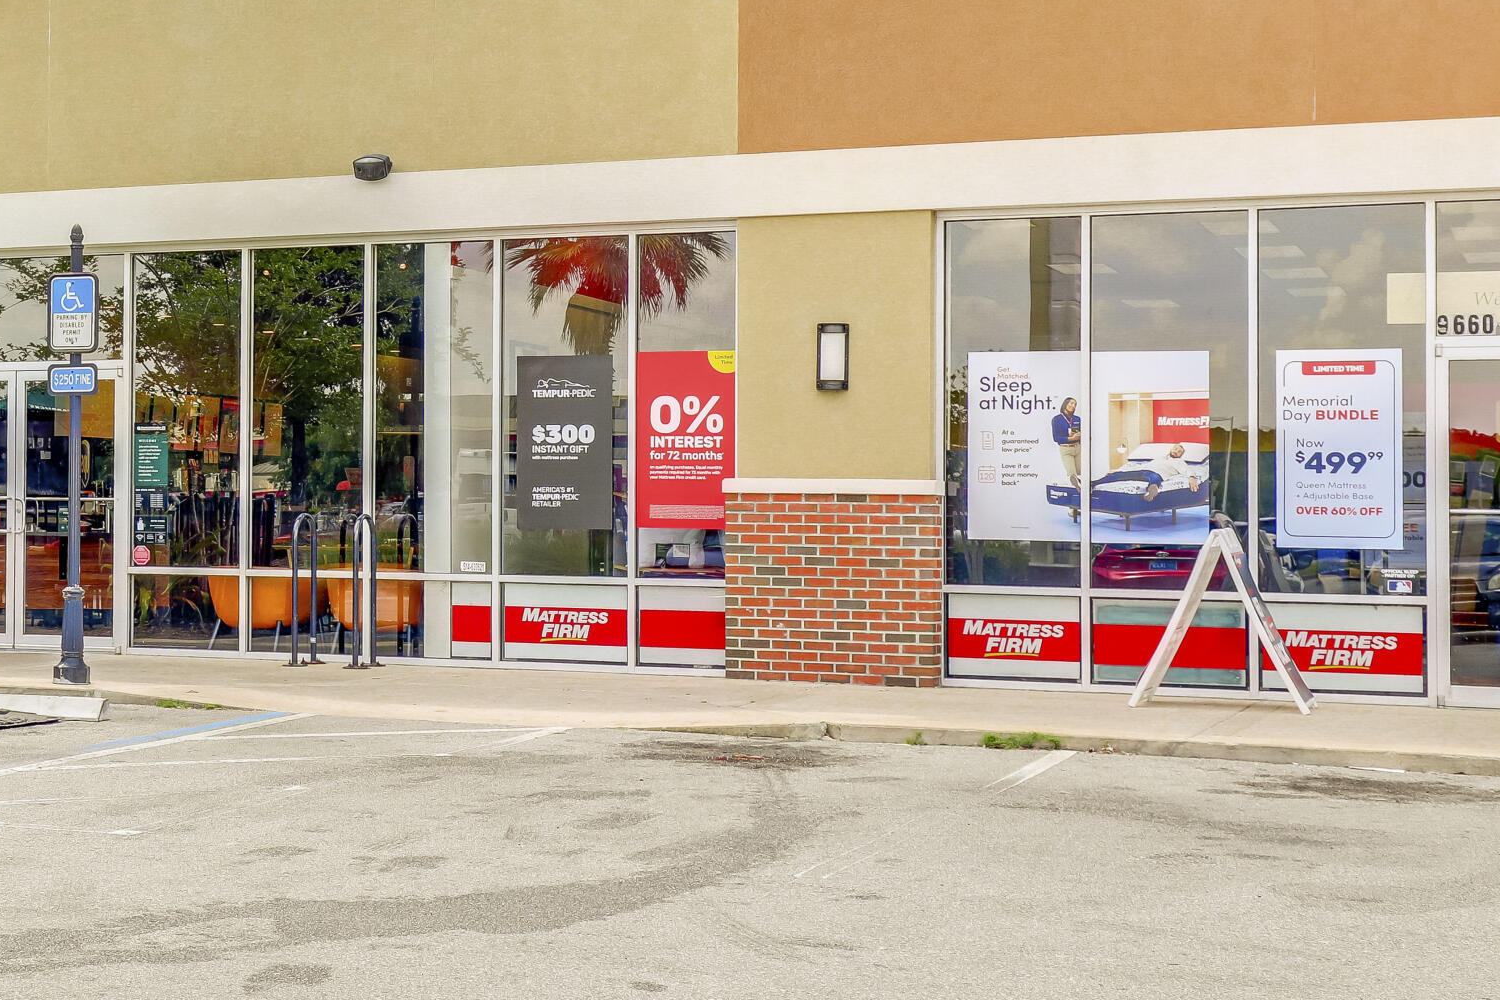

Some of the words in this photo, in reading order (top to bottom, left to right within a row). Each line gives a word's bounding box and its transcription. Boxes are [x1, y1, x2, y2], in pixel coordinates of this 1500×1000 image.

[1437, 313, 1494, 335] 9660
[1313, 365, 1344, 373] LIMITED
[53, 372, 74, 386] $250
[75, 373, 91, 385] FINE
[979, 376, 1032, 396] Sleep
[532, 389, 596, 398] TEMPUR-PEDIC
[979, 397, 998, 410] at
[1002, 394, 1056, 414] Night.
[1282, 395, 1353, 406] Memorial
[650, 395, 724, 434] 0%
[1283, 410, 1311, 423] Day
[1315, 410, 1379, 420] BUNDLE
[532, 424, 595, 444] $300
[650, 435, 724, 448] INTEREST
[1296, 438, 1324, 448] Now
[532, 445, 568, 453] INSTANT
[569, 445, 590, 453] GIFT
[649, 450, 665, 460] for
[667, 450, 680, 460] 72
[1296, 481, 1325, 489] Queen
[1328, 481, 1366, 489] Mattress
[532, 493, 580, 501] TEMPUR-PEDIC
[1303, 492, 1350, 501] Adjustable
[1352, 492, 1374, 500] Base
[1296, 506, 1328, 515] OVER
[1331, 506, 1357, 515] 60%
[1359, 507, 1384, 516] OFF
[522, 607, 608, 624] MATTRESS
[541, 623, 590, 639] FIRM
[963, 619, 1064, 638] MATTRESS
[986, 636, 1043, 654] FIRM
[1285, 631, 1398, 650] MATTRESS
[1310, 649, 1374, 667] FIRM
